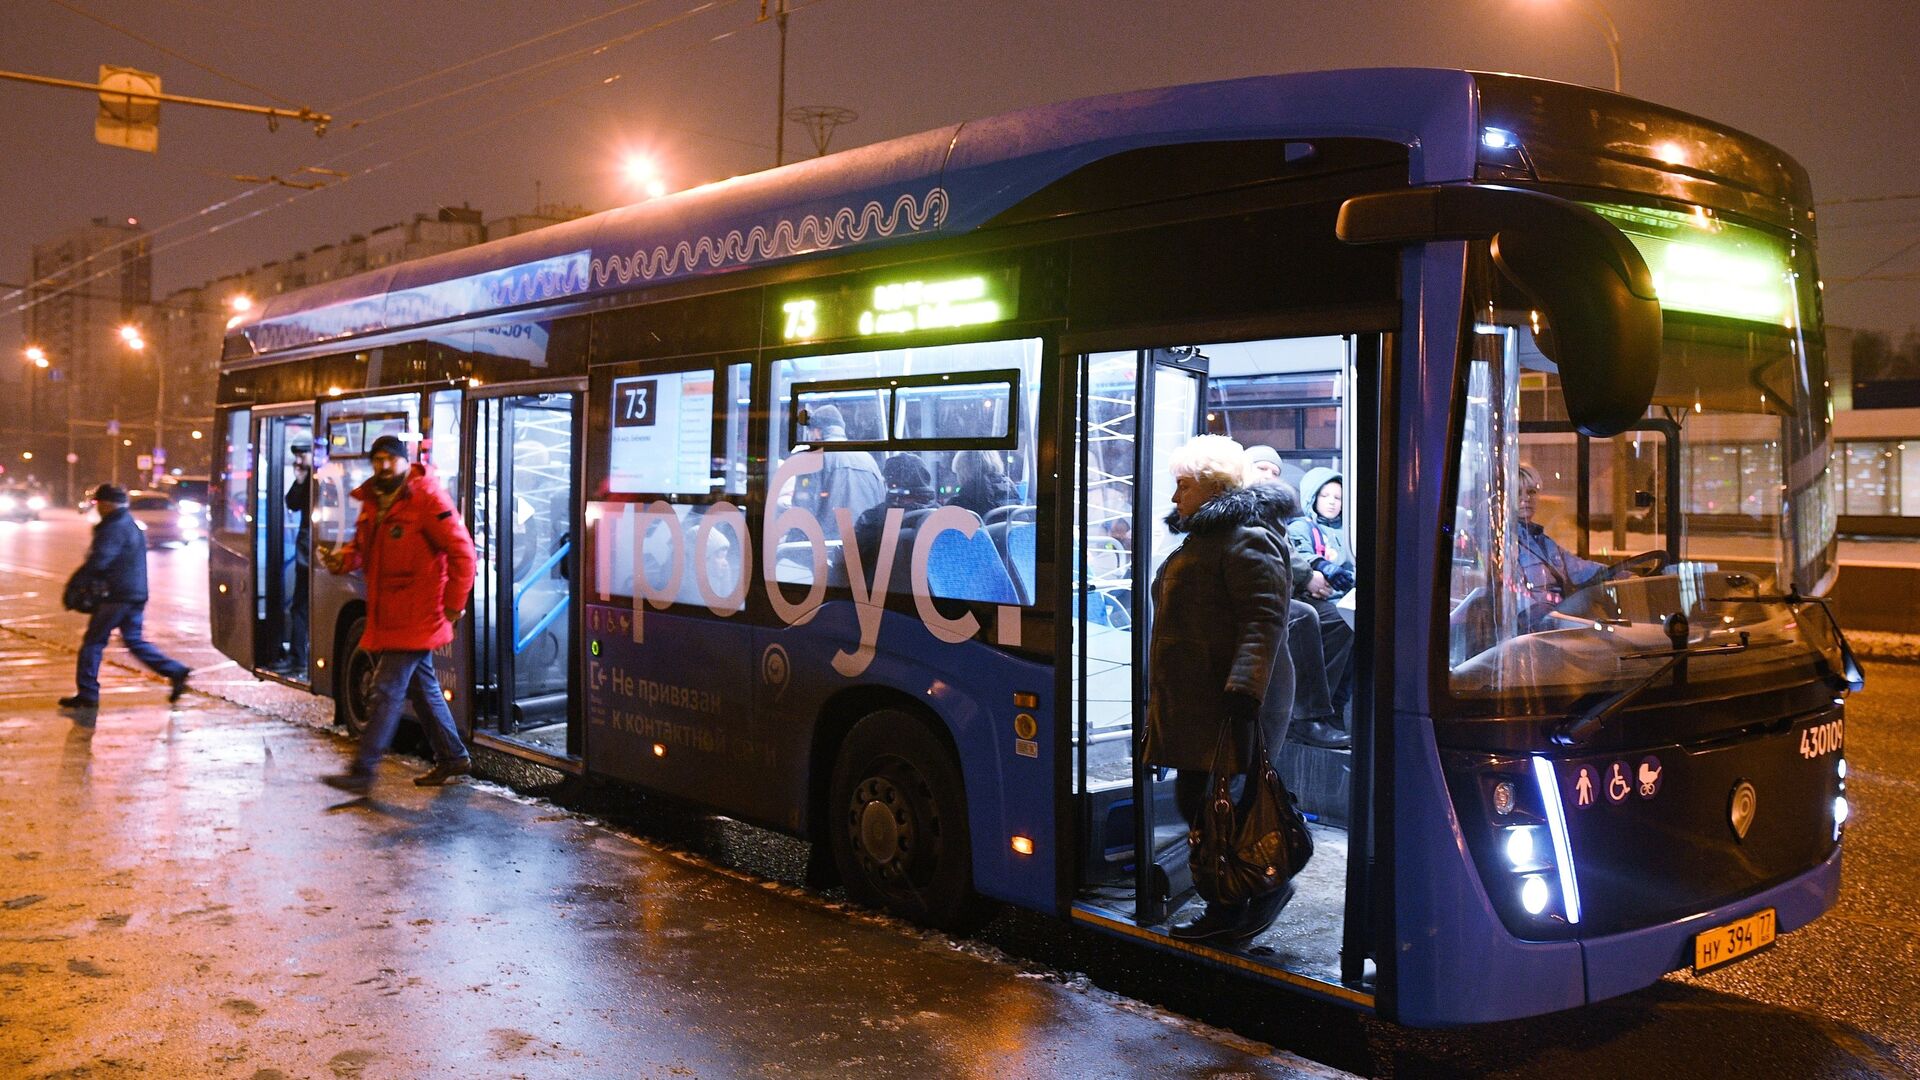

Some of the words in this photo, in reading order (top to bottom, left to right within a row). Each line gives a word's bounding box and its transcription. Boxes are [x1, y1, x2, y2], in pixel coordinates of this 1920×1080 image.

[783, 300, 816, 338] 73
[625, 389, 647, 419] 73
[612, 666, 634, 697] Не
[639, 679, 722, 714] привязан
[612, 709, 622, 730] к
[1800, 719, 1843, 760] 430109
[1727, 922, 1753, 954] 394
[1760, 913, 1771, 935] 77
